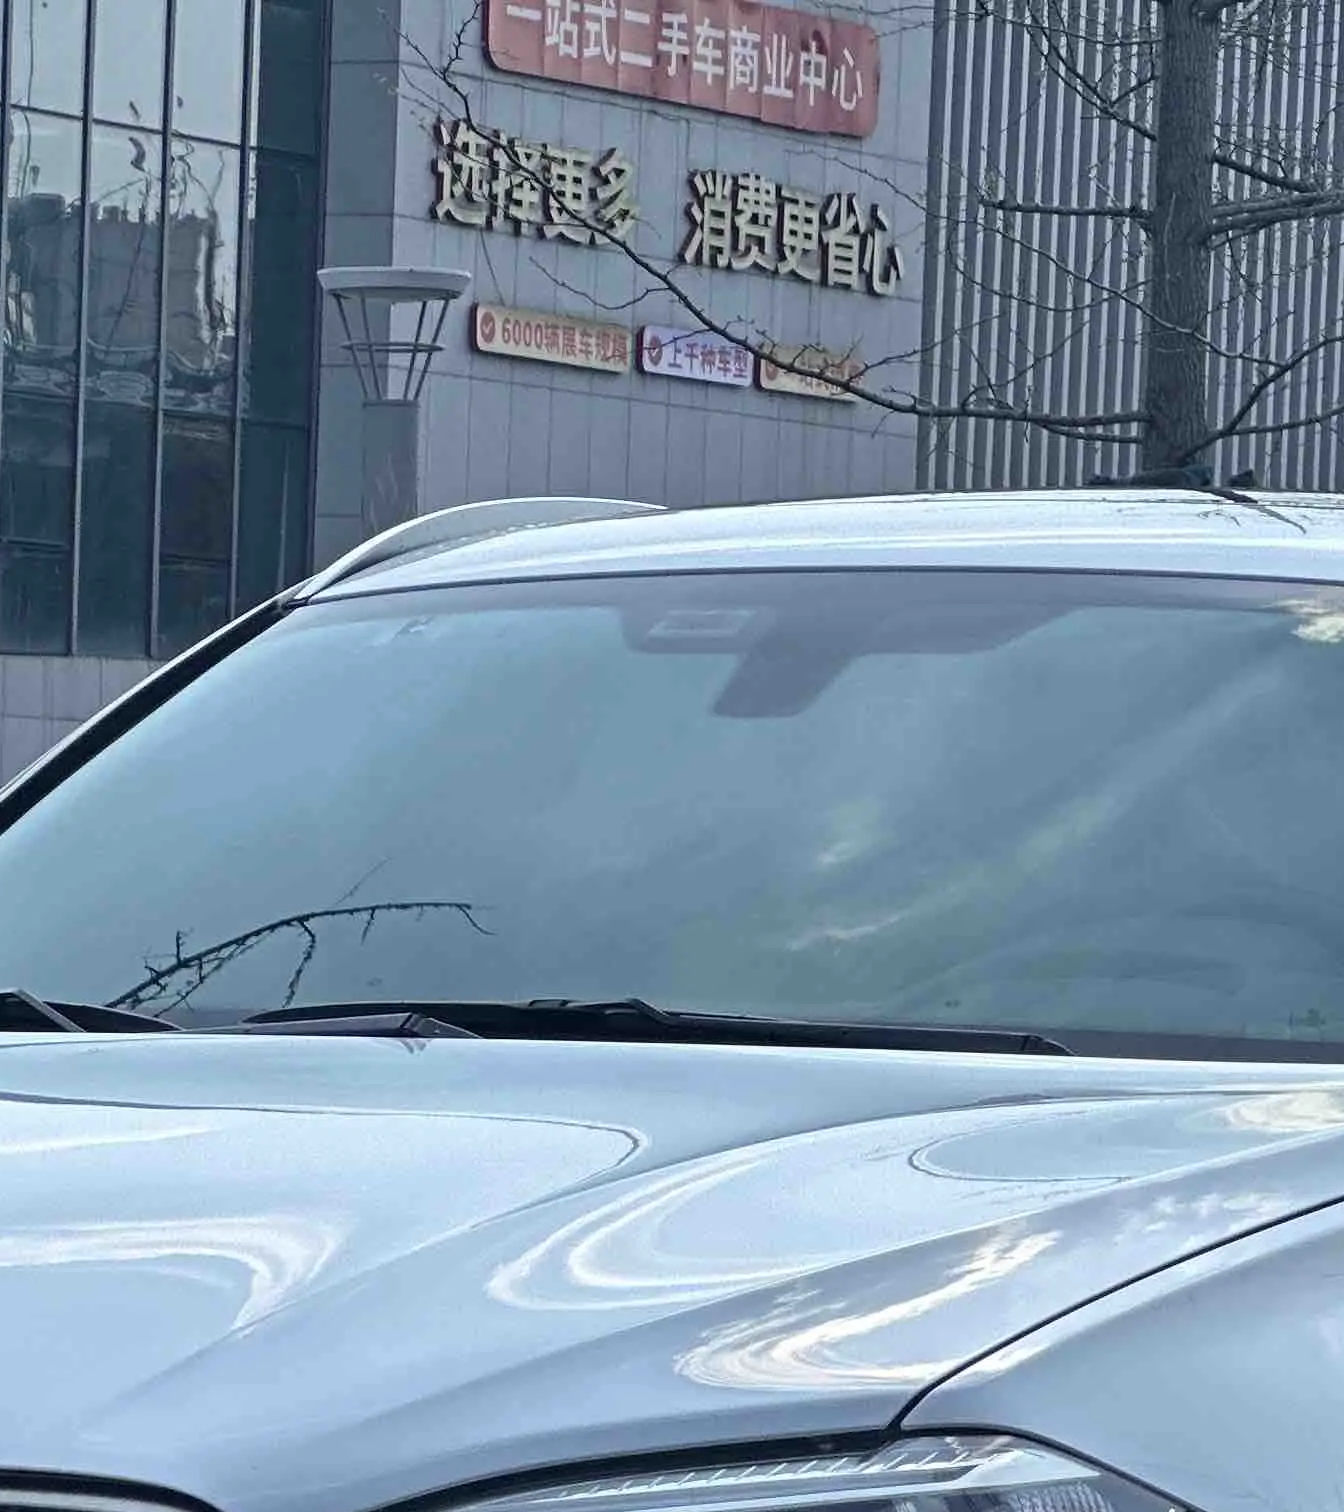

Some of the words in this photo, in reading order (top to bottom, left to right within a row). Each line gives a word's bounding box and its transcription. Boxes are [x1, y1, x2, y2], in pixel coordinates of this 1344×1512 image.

[506, 0, 864, 112] 一站式二手车商业中心
[433, 115, 638, 245] 选择更多
[680, 168, 905, 296] 消费更省心
